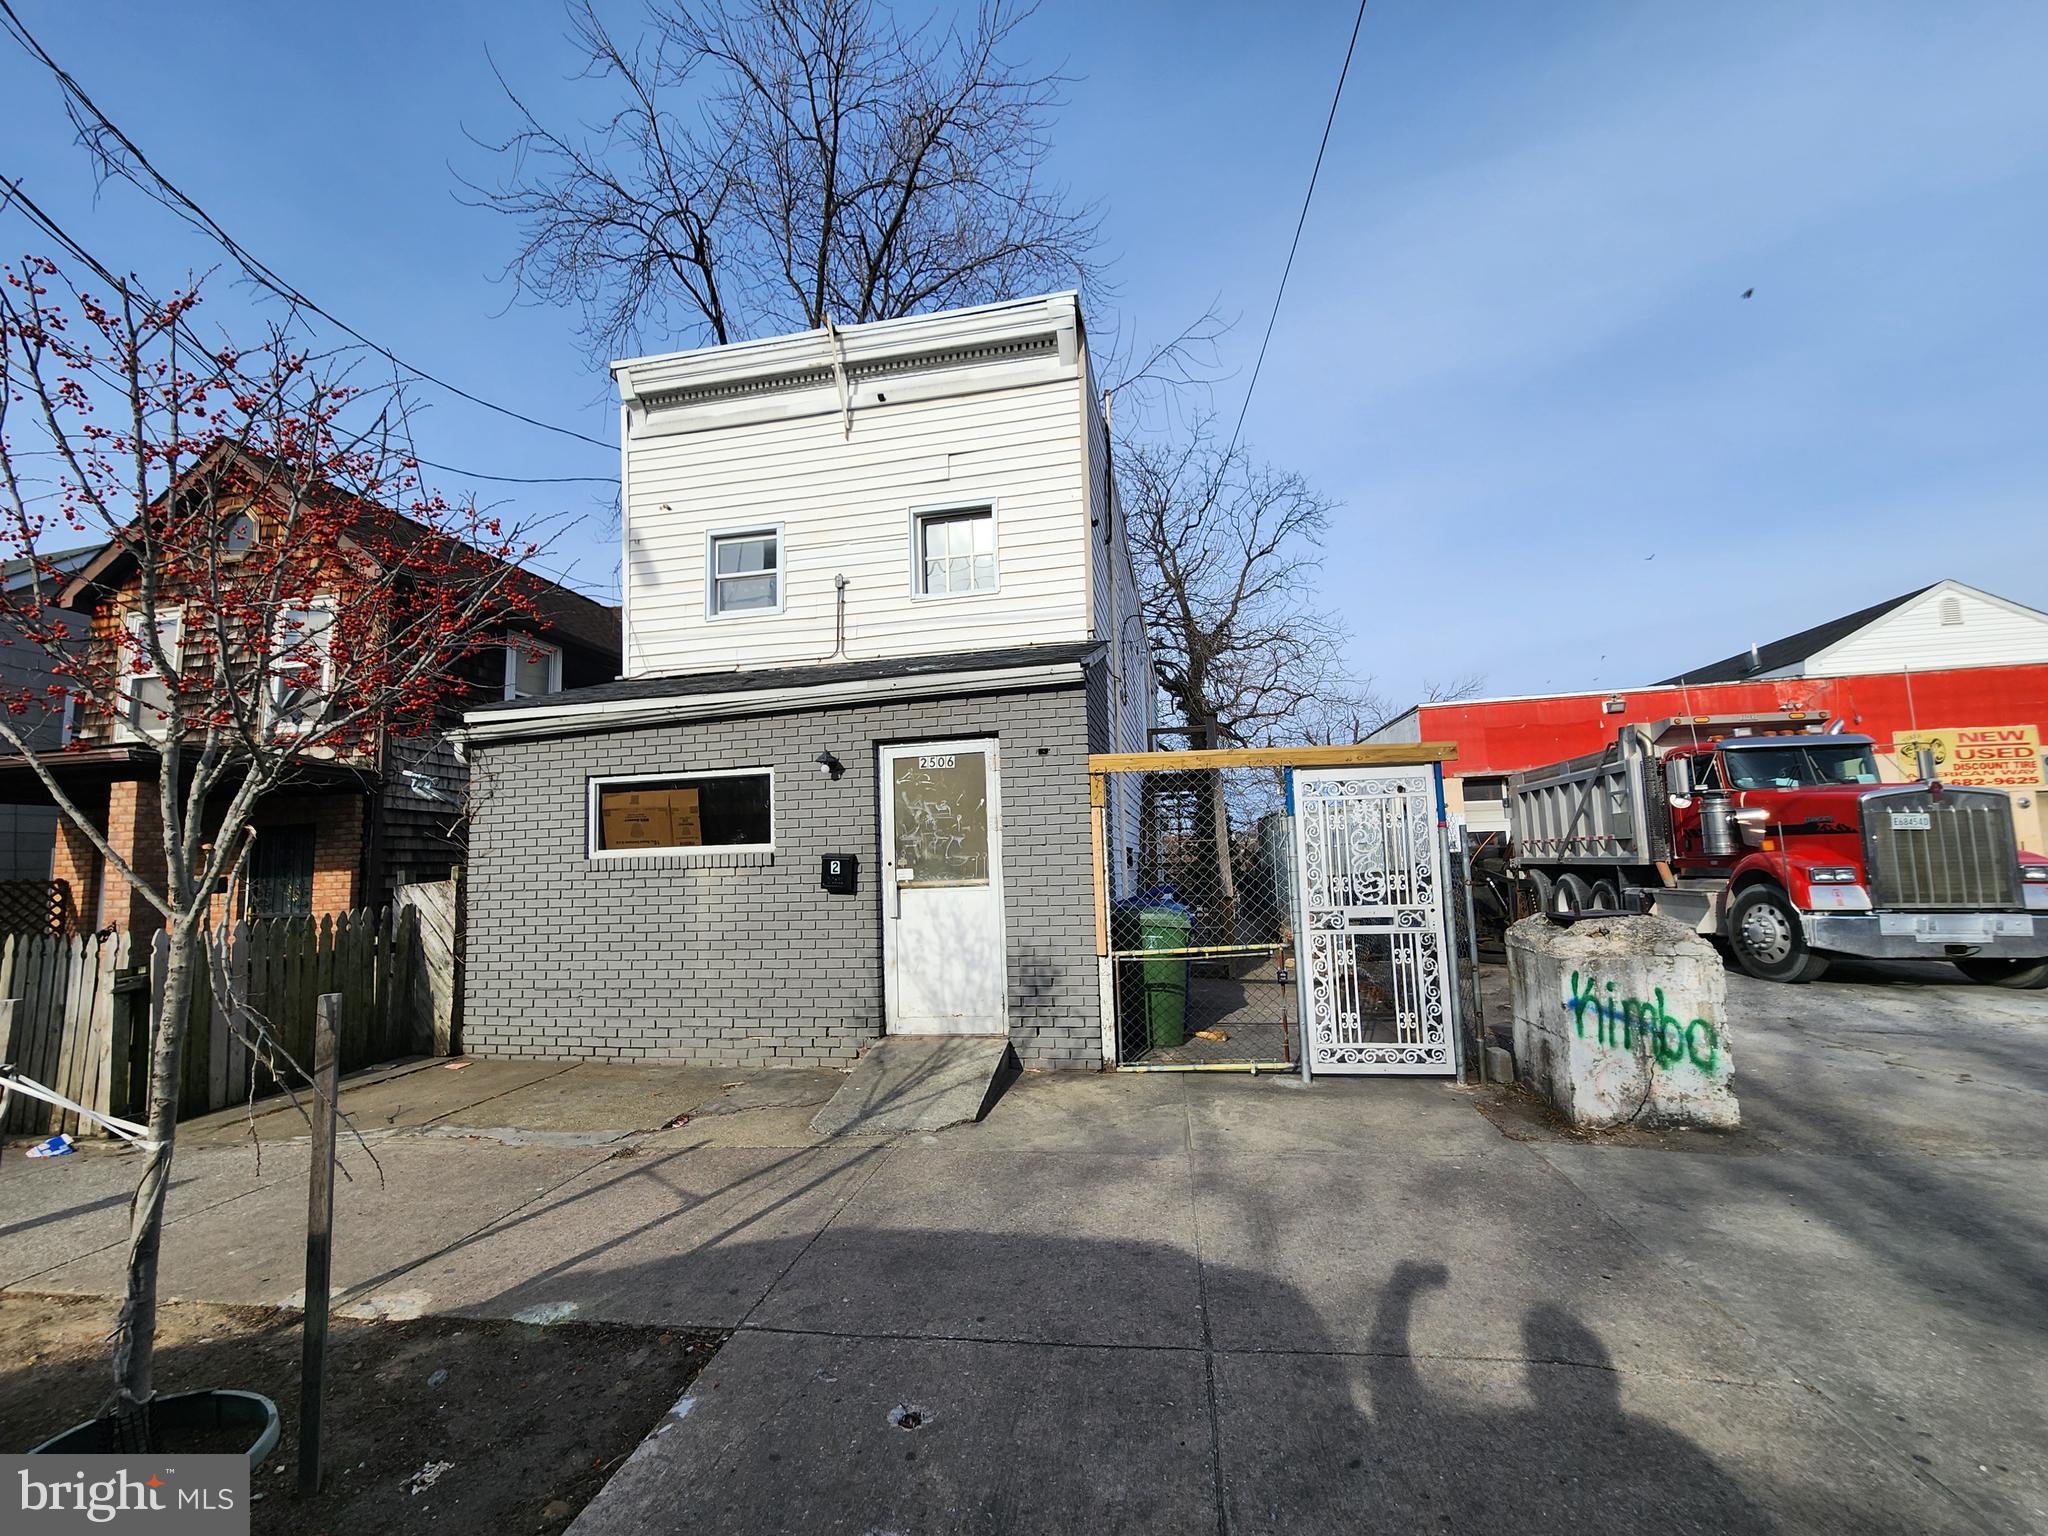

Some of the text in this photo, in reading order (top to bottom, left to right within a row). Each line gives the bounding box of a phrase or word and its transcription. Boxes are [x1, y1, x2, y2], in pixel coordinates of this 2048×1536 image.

[1957, 730, 2025, 743] NEW
[1955, 747, 2035, 760] USED
[919, 756, 954, 769] 2506
[1953, 760, 2038, 771] DISCOUNT TIRE
[1906, 768, 2037, 778] AERICAN WAY
[832, 861, 839, 873] 2
